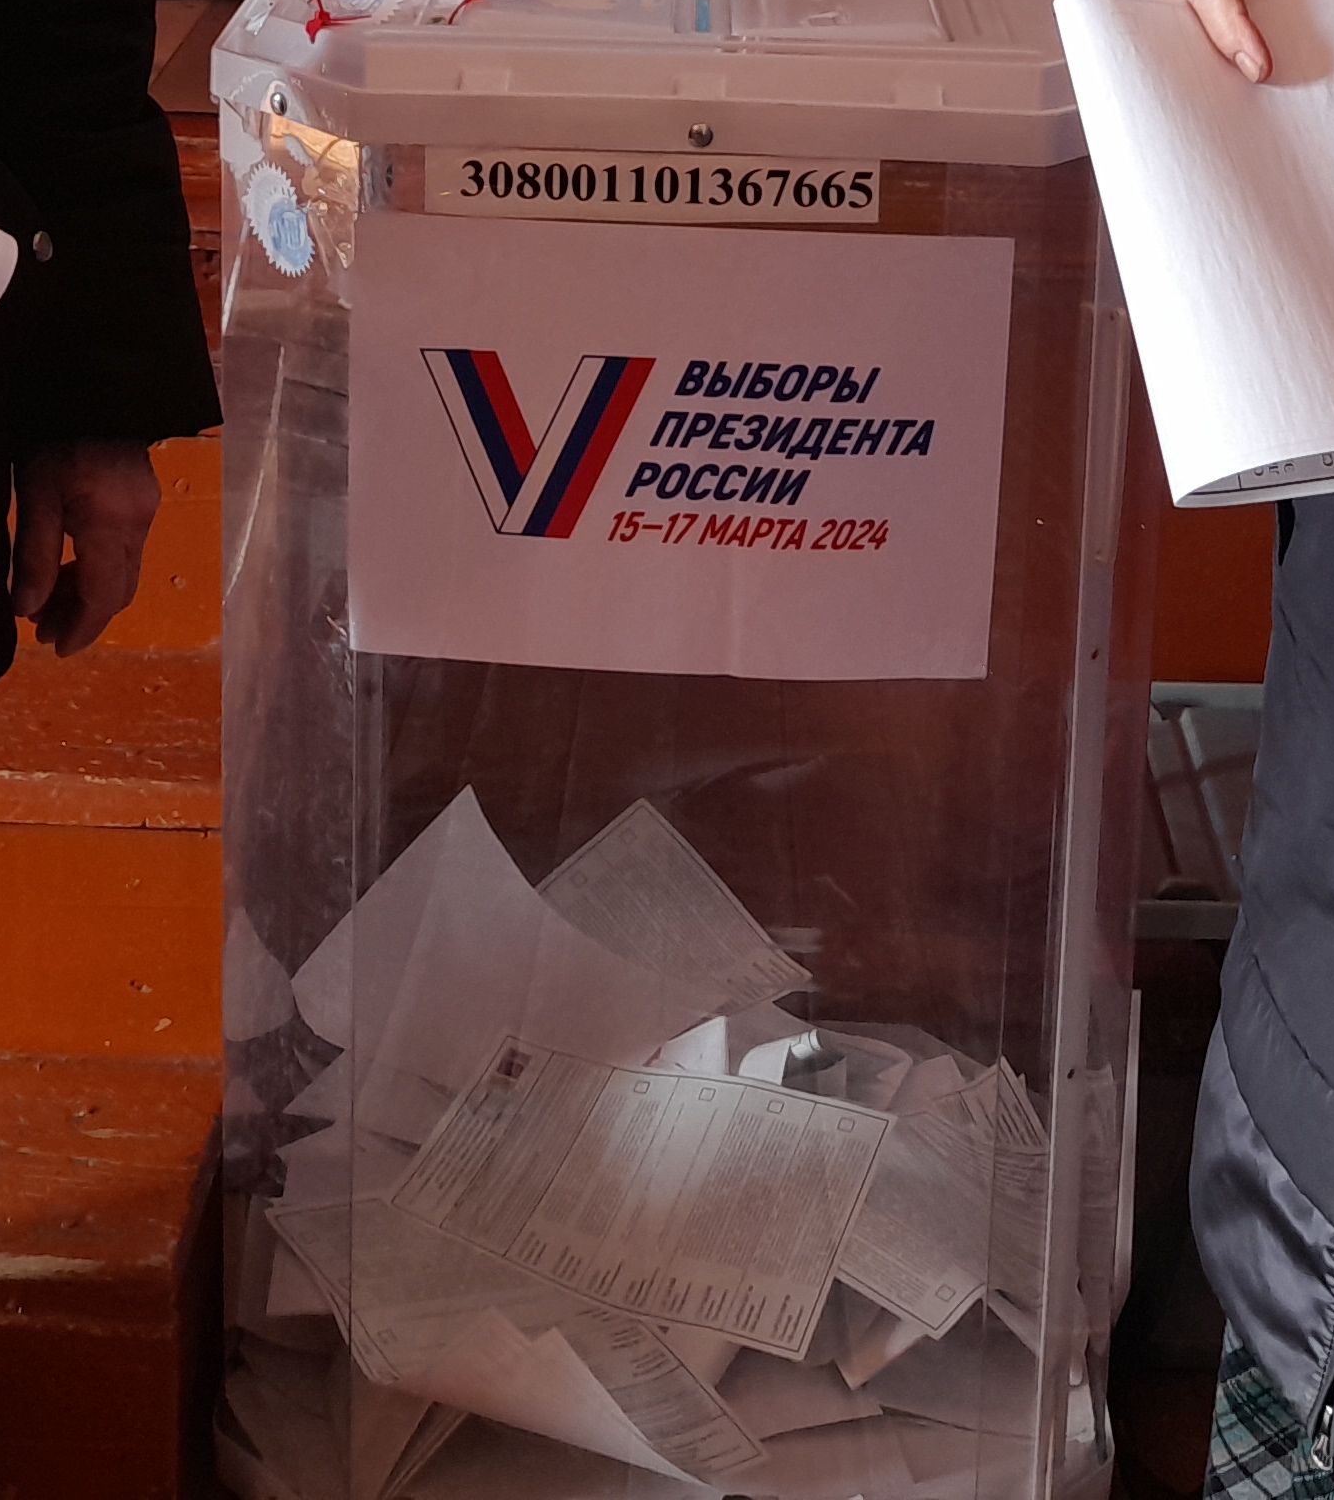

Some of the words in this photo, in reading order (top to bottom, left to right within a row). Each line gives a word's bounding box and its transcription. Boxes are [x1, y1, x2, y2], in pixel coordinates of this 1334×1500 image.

[460, 160, 874, 210] 308001101367665
[674, 360, 881, 403] ВЫБОРЫ
[650, 411, 936, 460] ПРЕЗИДЕНТА
[625, 462, 811, 506] РОССИИ
[698, 515, 805, 551] МАРТА
[809, 519, 889, 551] 2024
